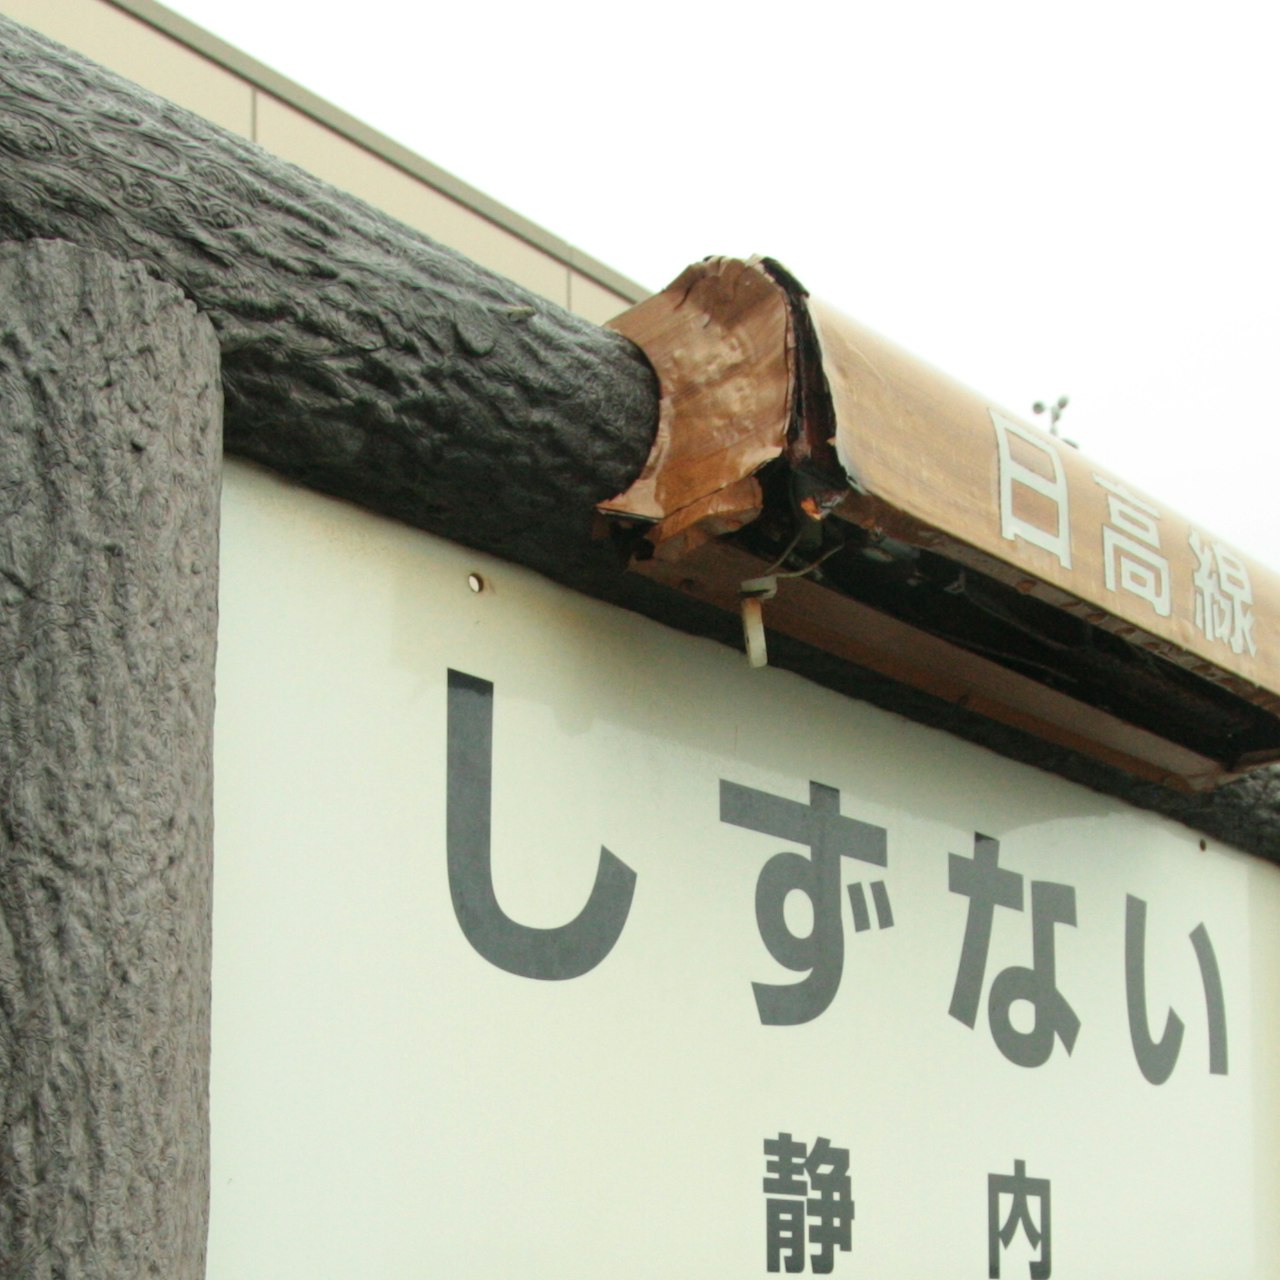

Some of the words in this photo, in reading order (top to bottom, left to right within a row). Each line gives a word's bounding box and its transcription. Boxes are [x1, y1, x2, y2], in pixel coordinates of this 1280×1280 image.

[988, 407, 1257, 657] 日高線
[445, 667, 1230, 1087] しずない
